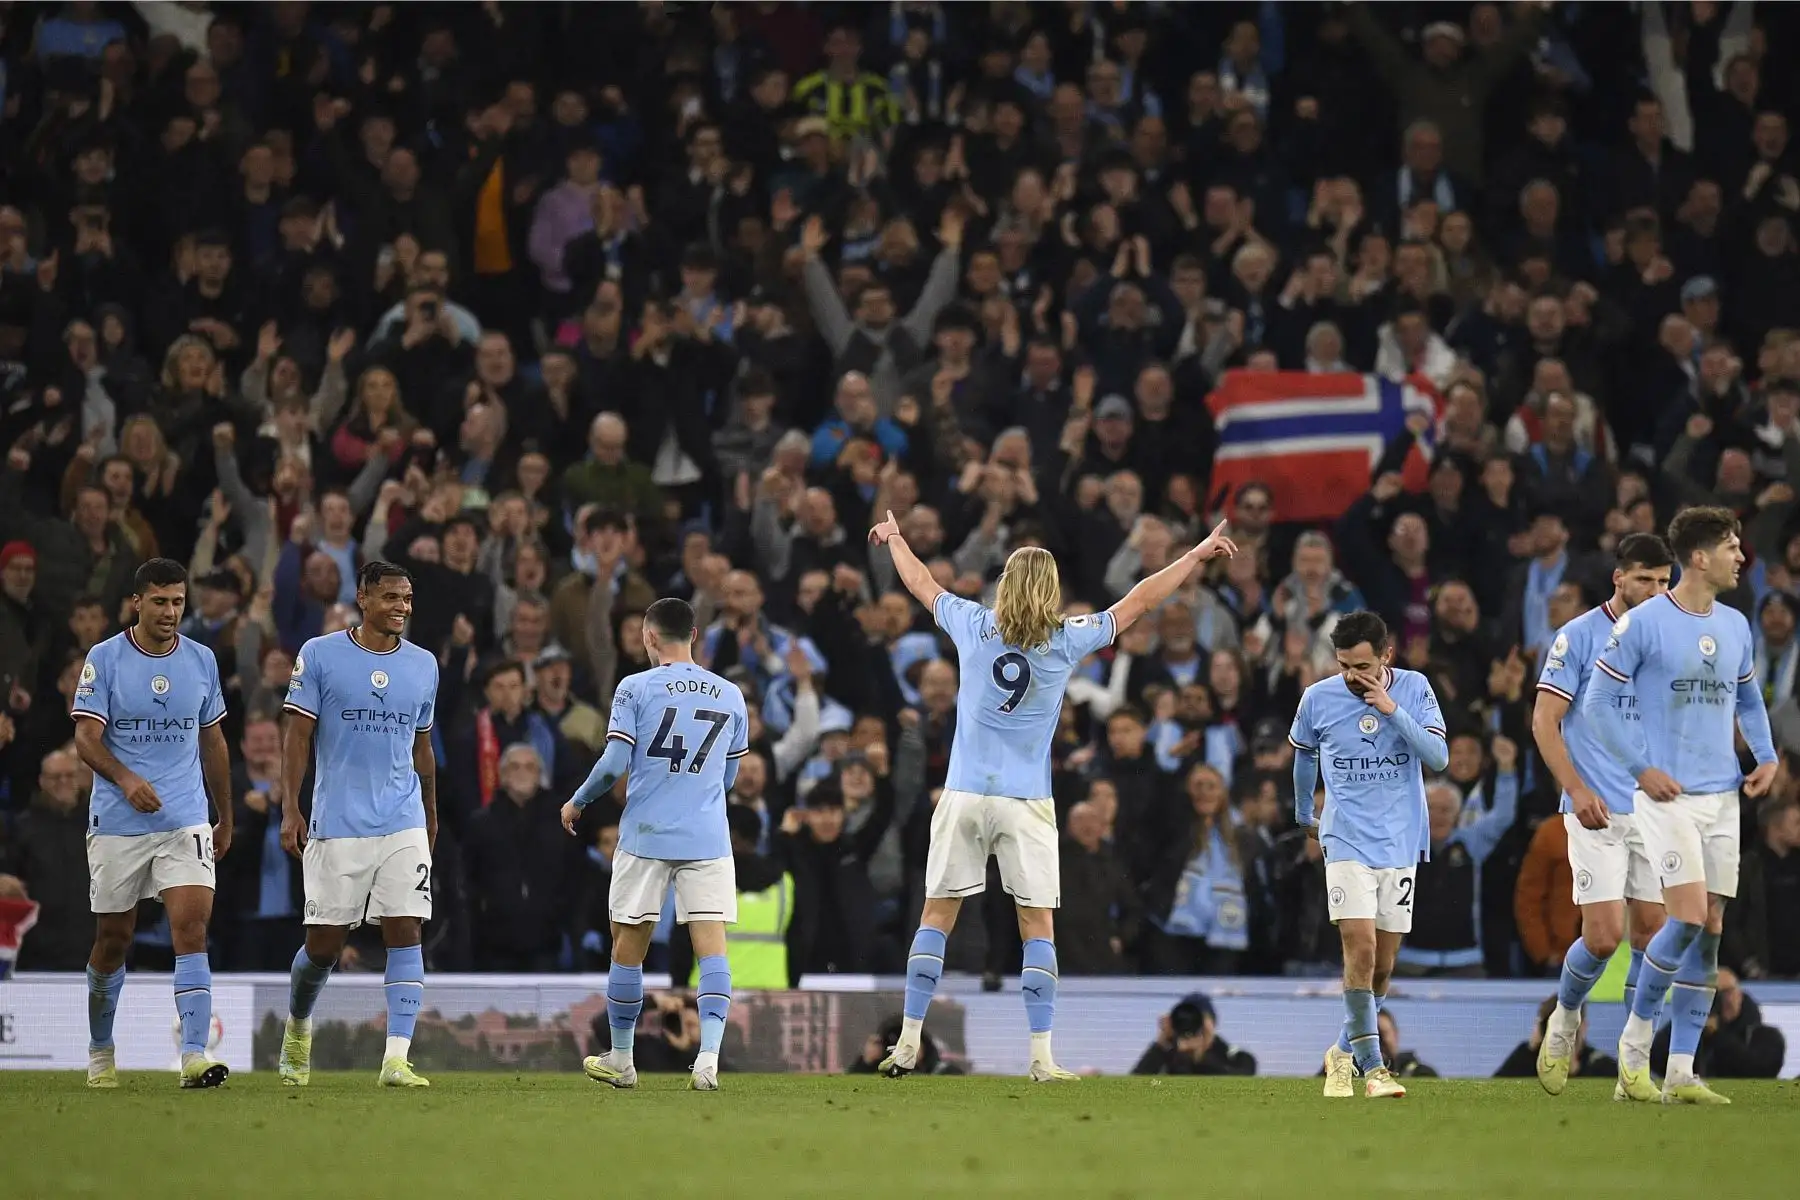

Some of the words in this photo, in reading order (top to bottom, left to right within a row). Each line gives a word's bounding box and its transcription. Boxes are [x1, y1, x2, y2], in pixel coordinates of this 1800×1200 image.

[665, 680, 722, 699] FODEN
[992, 652, 1032, 714] 9
[1685, 695, 1725, 705] AIRWAY
[115, 717, 195, 731] ETIHAD
[341, 708, 411, 725] ETIHAD
[353, 724, 399, 735] AIRWAYS
[130, 734, 185, 743] AIRWAYS
[646, 706, 732, 775] 47
[1332, 752, 1410, 770] ETIHAD
[1345, 769, 1399, 782] AIRWAYS
